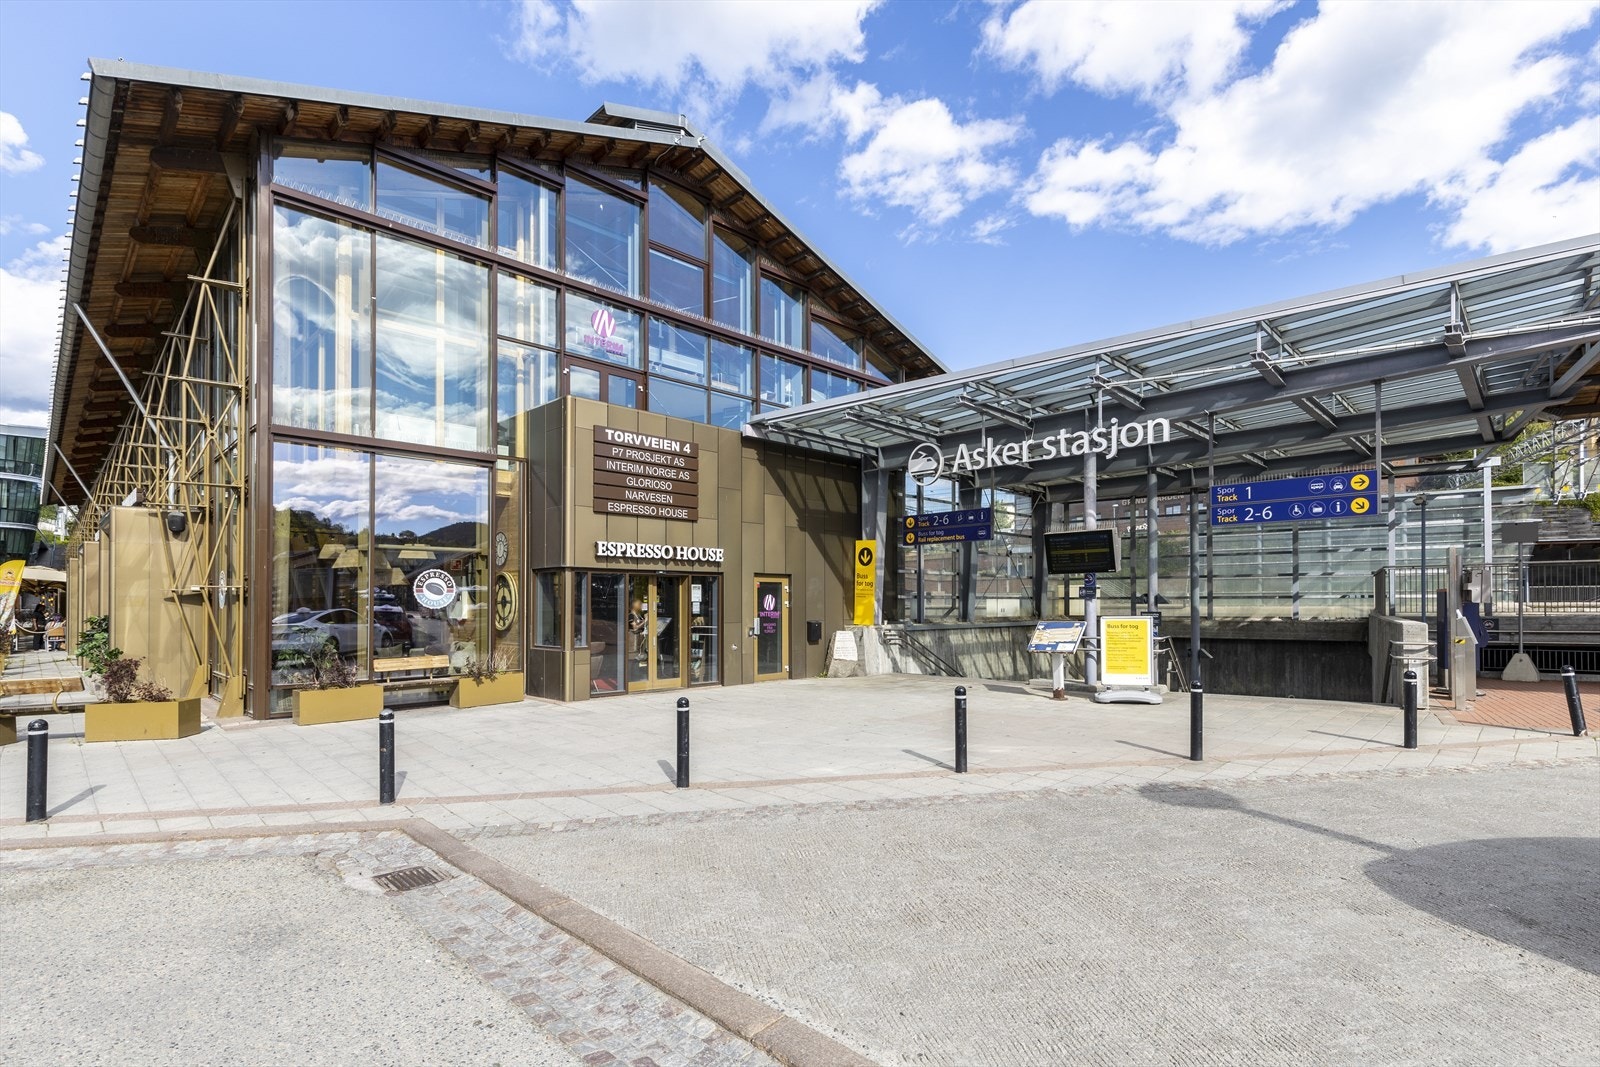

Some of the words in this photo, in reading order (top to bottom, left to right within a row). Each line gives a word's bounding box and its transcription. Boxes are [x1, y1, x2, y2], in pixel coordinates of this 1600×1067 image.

[583, 334, 624, 354] INTERIM
[605, 429, 680, 452] TORVVEIEN
[683, 443, 691, 454] 4
[952, 437, 1034, 473] Asker
[1042, 417, 1170, 459] stasjon
[612, 447, 624, 457] P7
[626, 449, 672, 465] PROSJEKT
[674, 457, 685, 467] AS
[606, 460, 644, 474] INTERIM
[646, 467, 677, 479] NORGE
[679, 471, 690, 480] AS
[626, 476, 672, 491] GLORIOSO
[625, 490, 673, 503] NARVESEN
[1217, 487, 1235, 498] Spor
[1217, 495, 1238, 503] Track
[1245, 486, 1252, 500] 1
[607, 502, 657, 515] ESPRESSO
[659, 508, 688, 518] HOUSE
[1217, 508, 1235, 519] Spor
[1244, 506, 1273, 521] 2-6
[933, 514, 949, 526] 2-6
[597, 541, 673, 559] ESPRESSO
[676, 546, 724, 561] HOUSE
[417, 571, 453, 587] ESPRESSO
[422, 594, 448, 607] HOUSE
